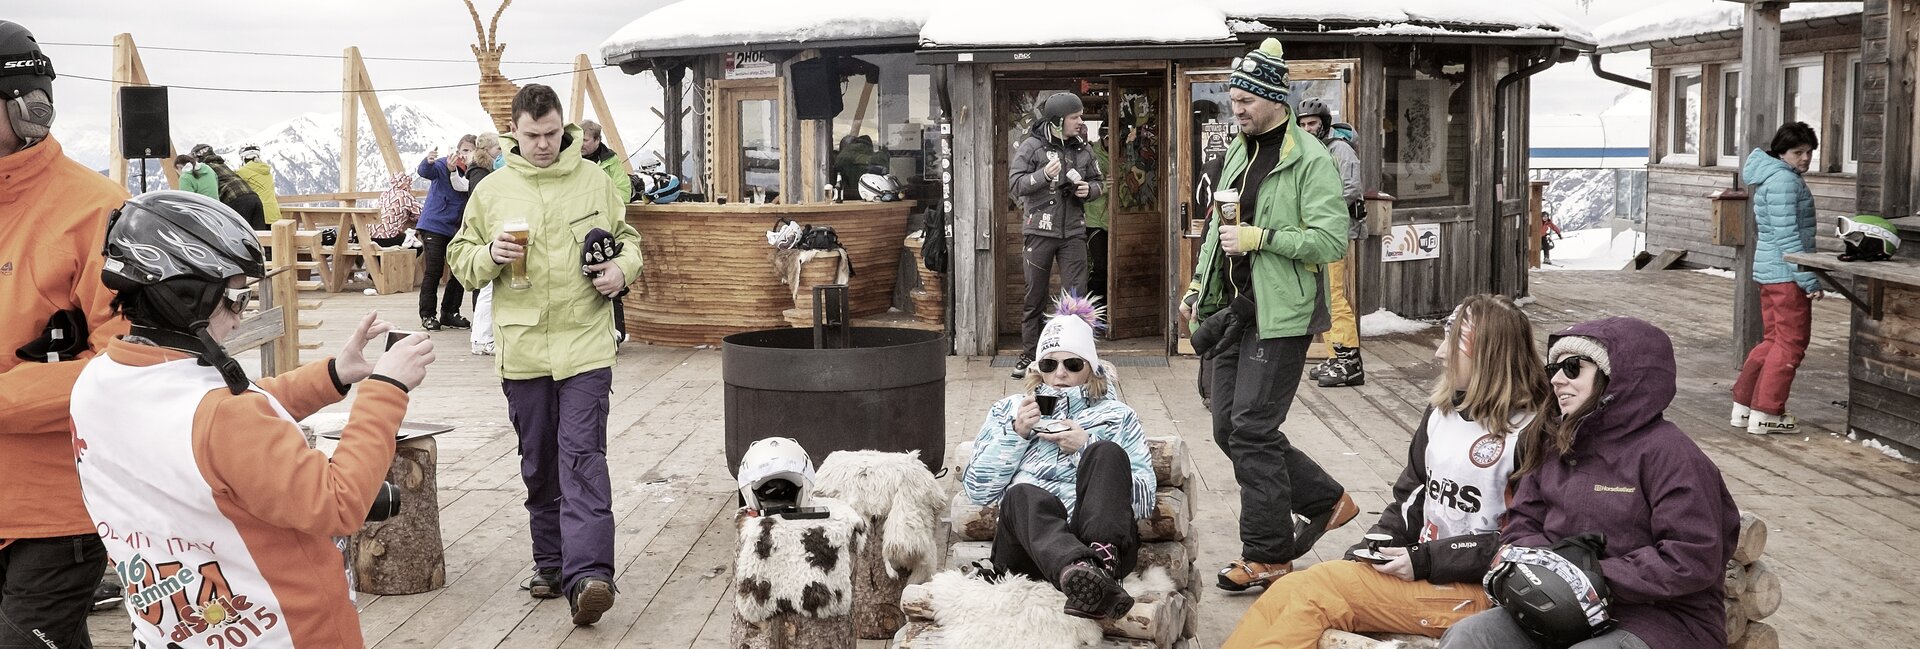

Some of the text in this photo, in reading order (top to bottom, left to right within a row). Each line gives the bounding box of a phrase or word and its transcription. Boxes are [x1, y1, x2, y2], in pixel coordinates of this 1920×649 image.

[1758, 421, 1795, 430] HEAD
[116, 553, 146, 587] 16
[206, 606, 279, 649] 2015
